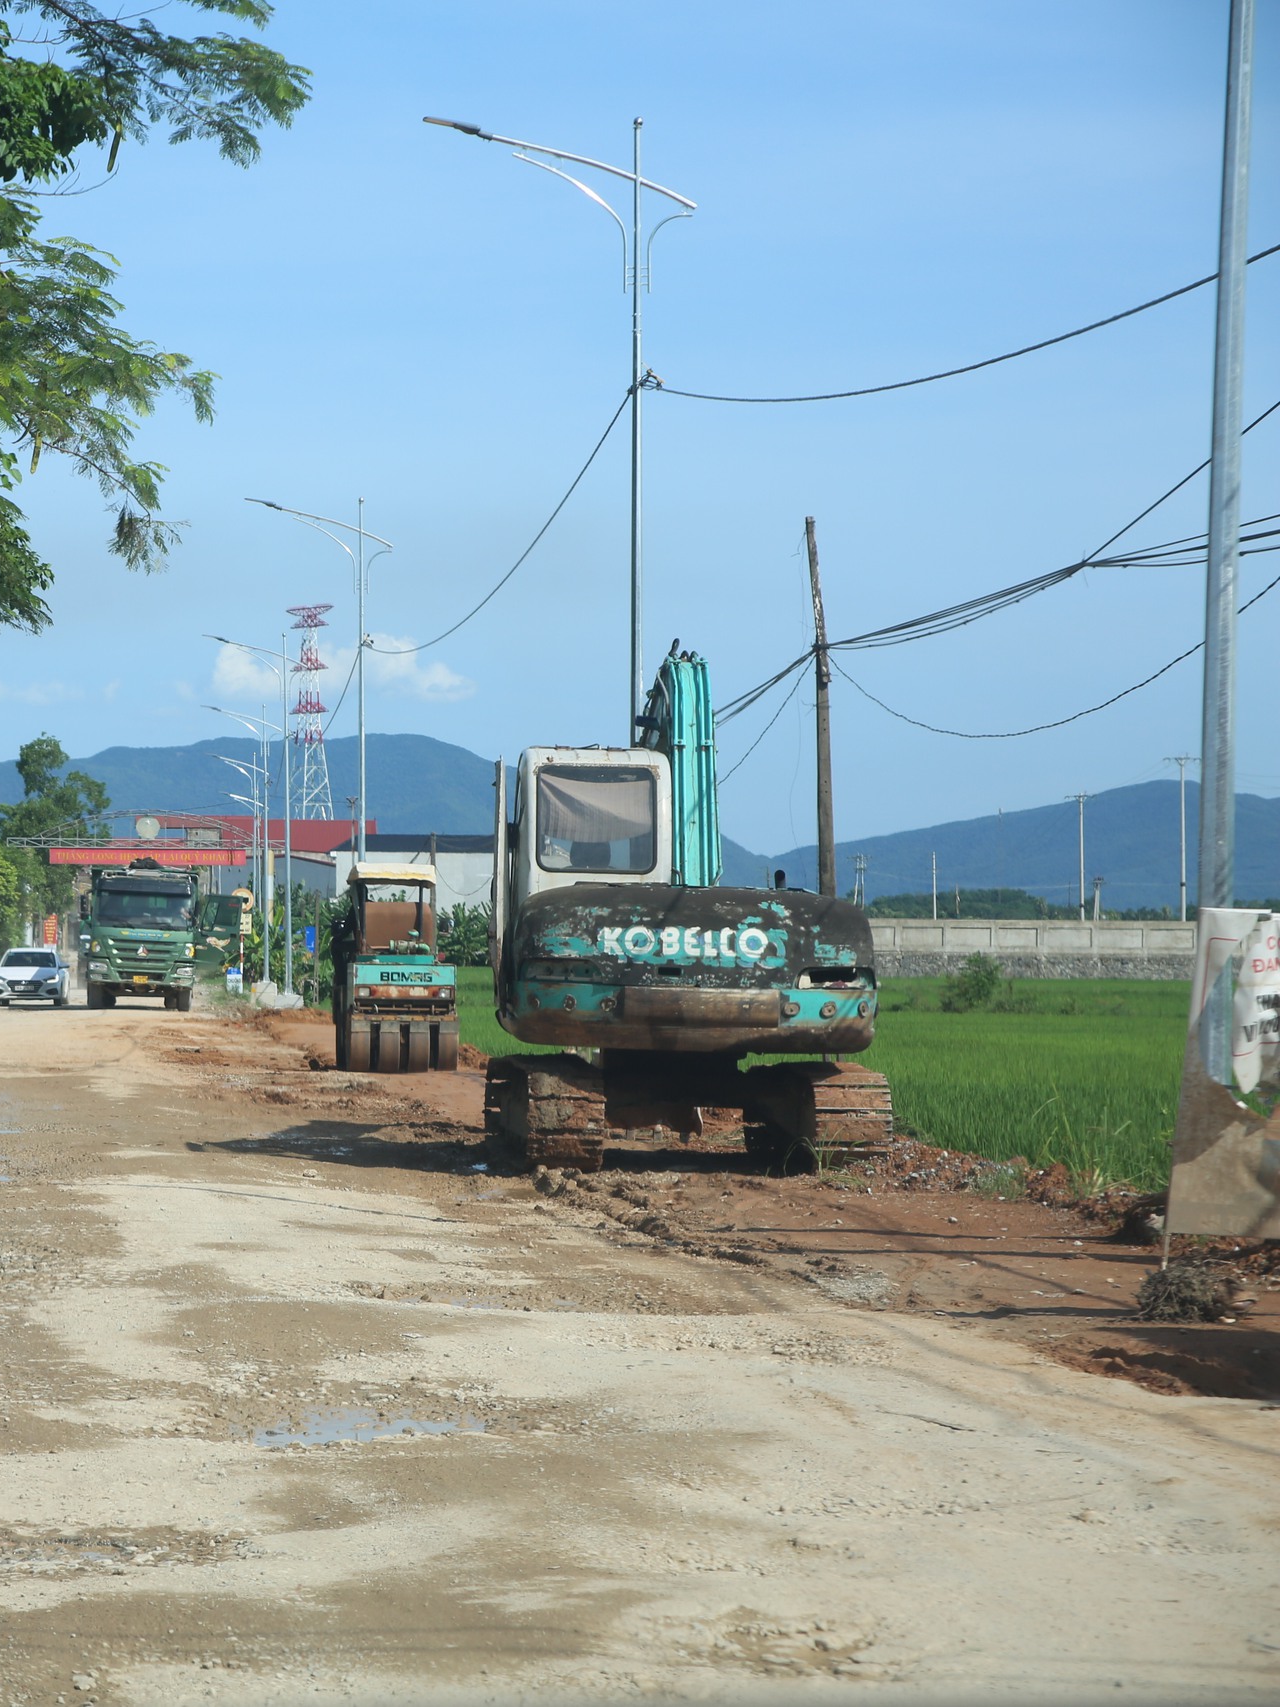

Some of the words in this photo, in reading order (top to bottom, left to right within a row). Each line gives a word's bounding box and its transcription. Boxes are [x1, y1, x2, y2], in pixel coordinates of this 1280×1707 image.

[92, 852, 117, 860] LONG
[598, 926, 769, 959] KOBELCO
[380, 971, 433, 983] BOMAG
